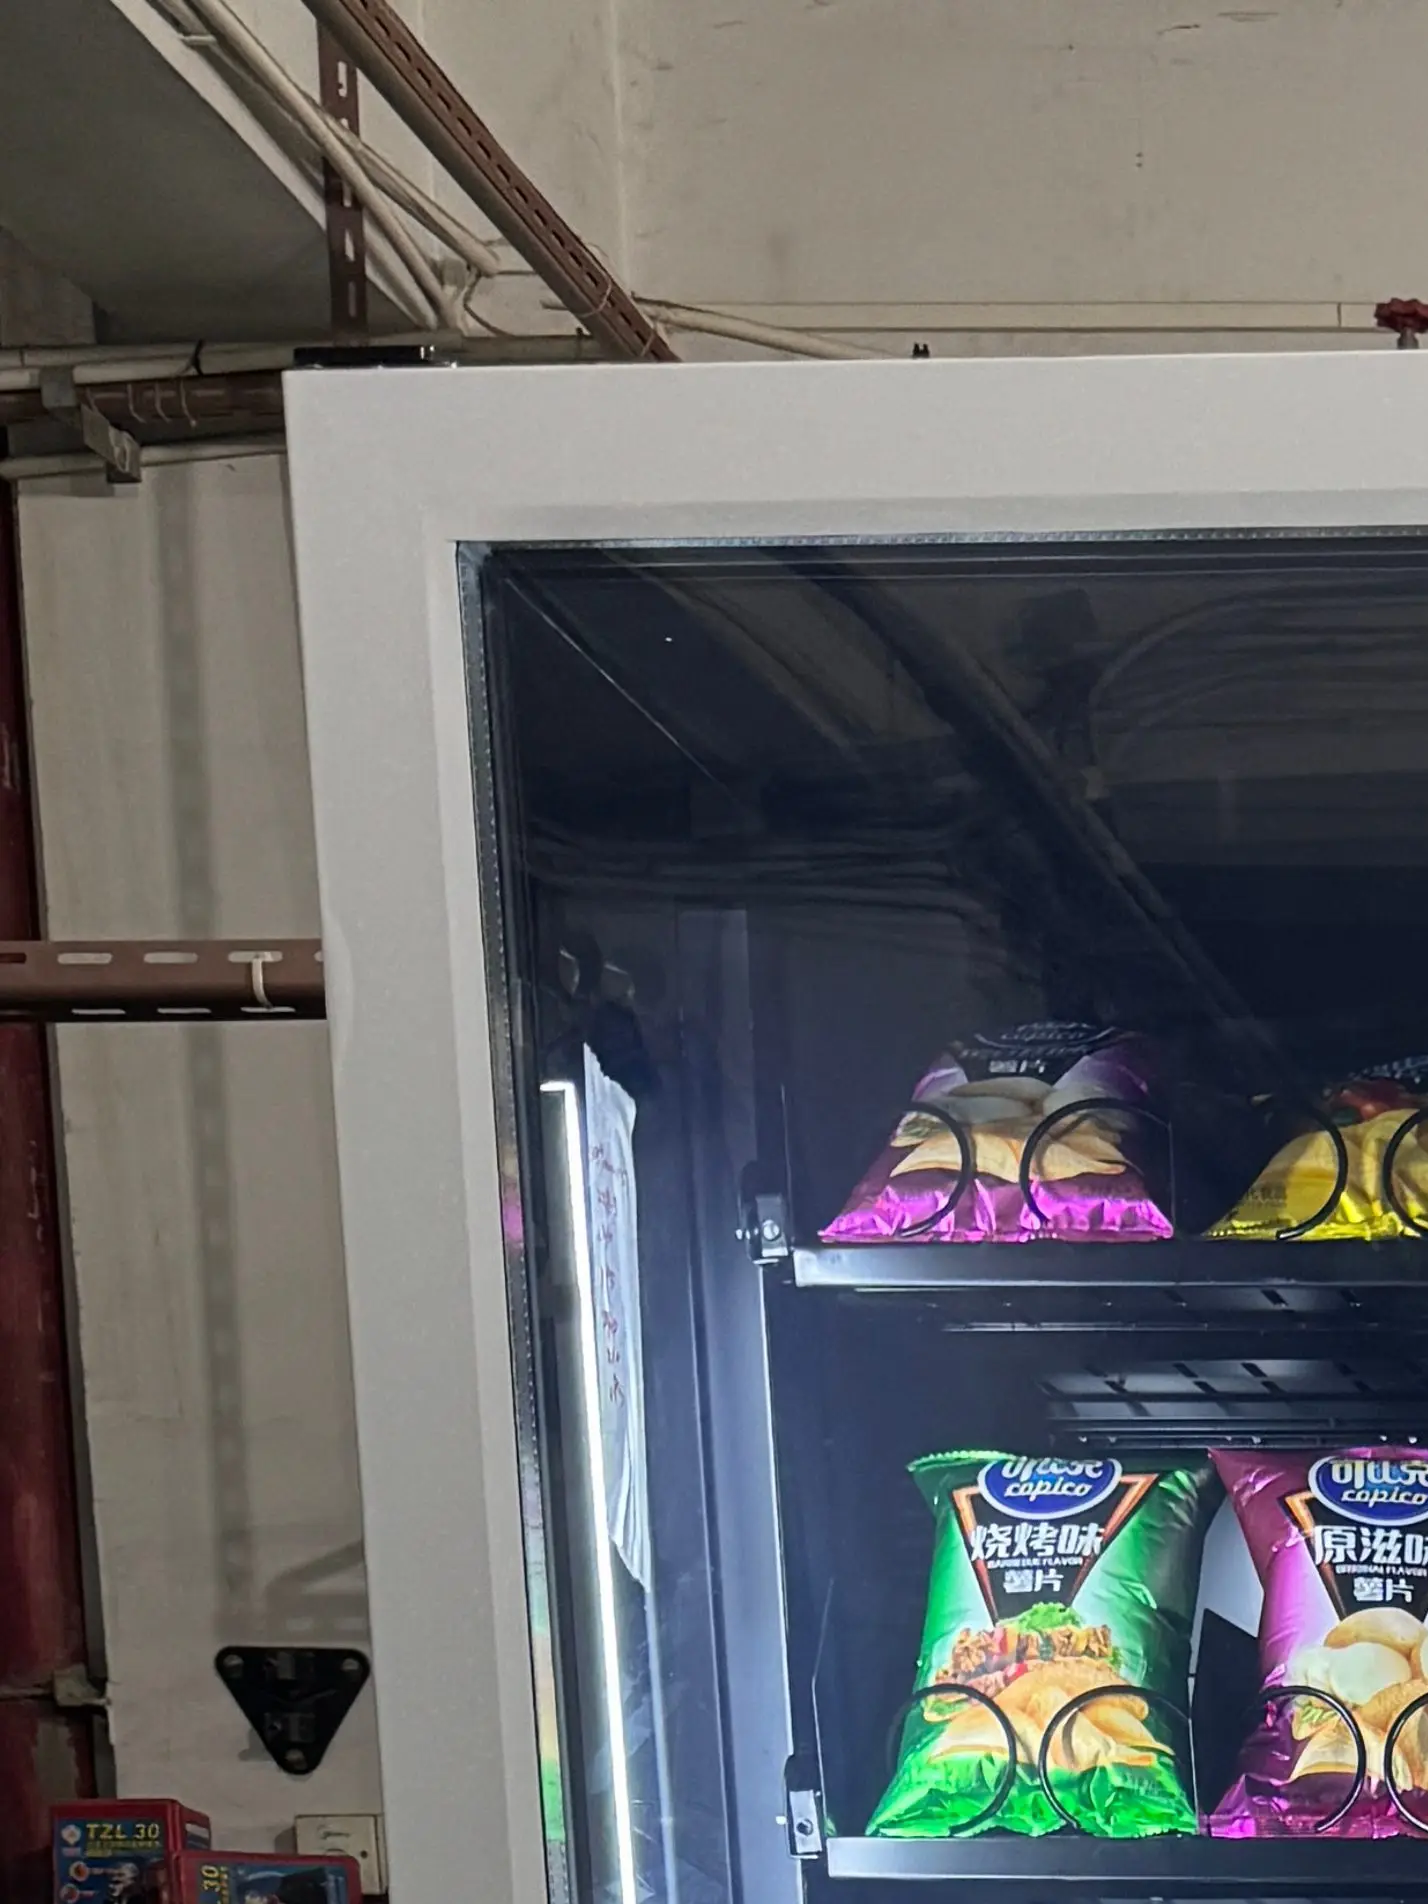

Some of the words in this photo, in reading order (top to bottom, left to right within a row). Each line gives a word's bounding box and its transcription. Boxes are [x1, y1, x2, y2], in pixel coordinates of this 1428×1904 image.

[1004, 1479, 1094, 1501] copico
[1341, 1486, 1428, 1506] copico
[971, 1523, 1106, 1560] 烧烤味
[1003, 1569, 1064, 1593] 薯片
[1353, 1576, 1414, 1602] 薯片
[85, 1824, 128, 1840] TZL
[133, 1823, 160, 1840] 30
[202, 1864, 221, 1893] 30
